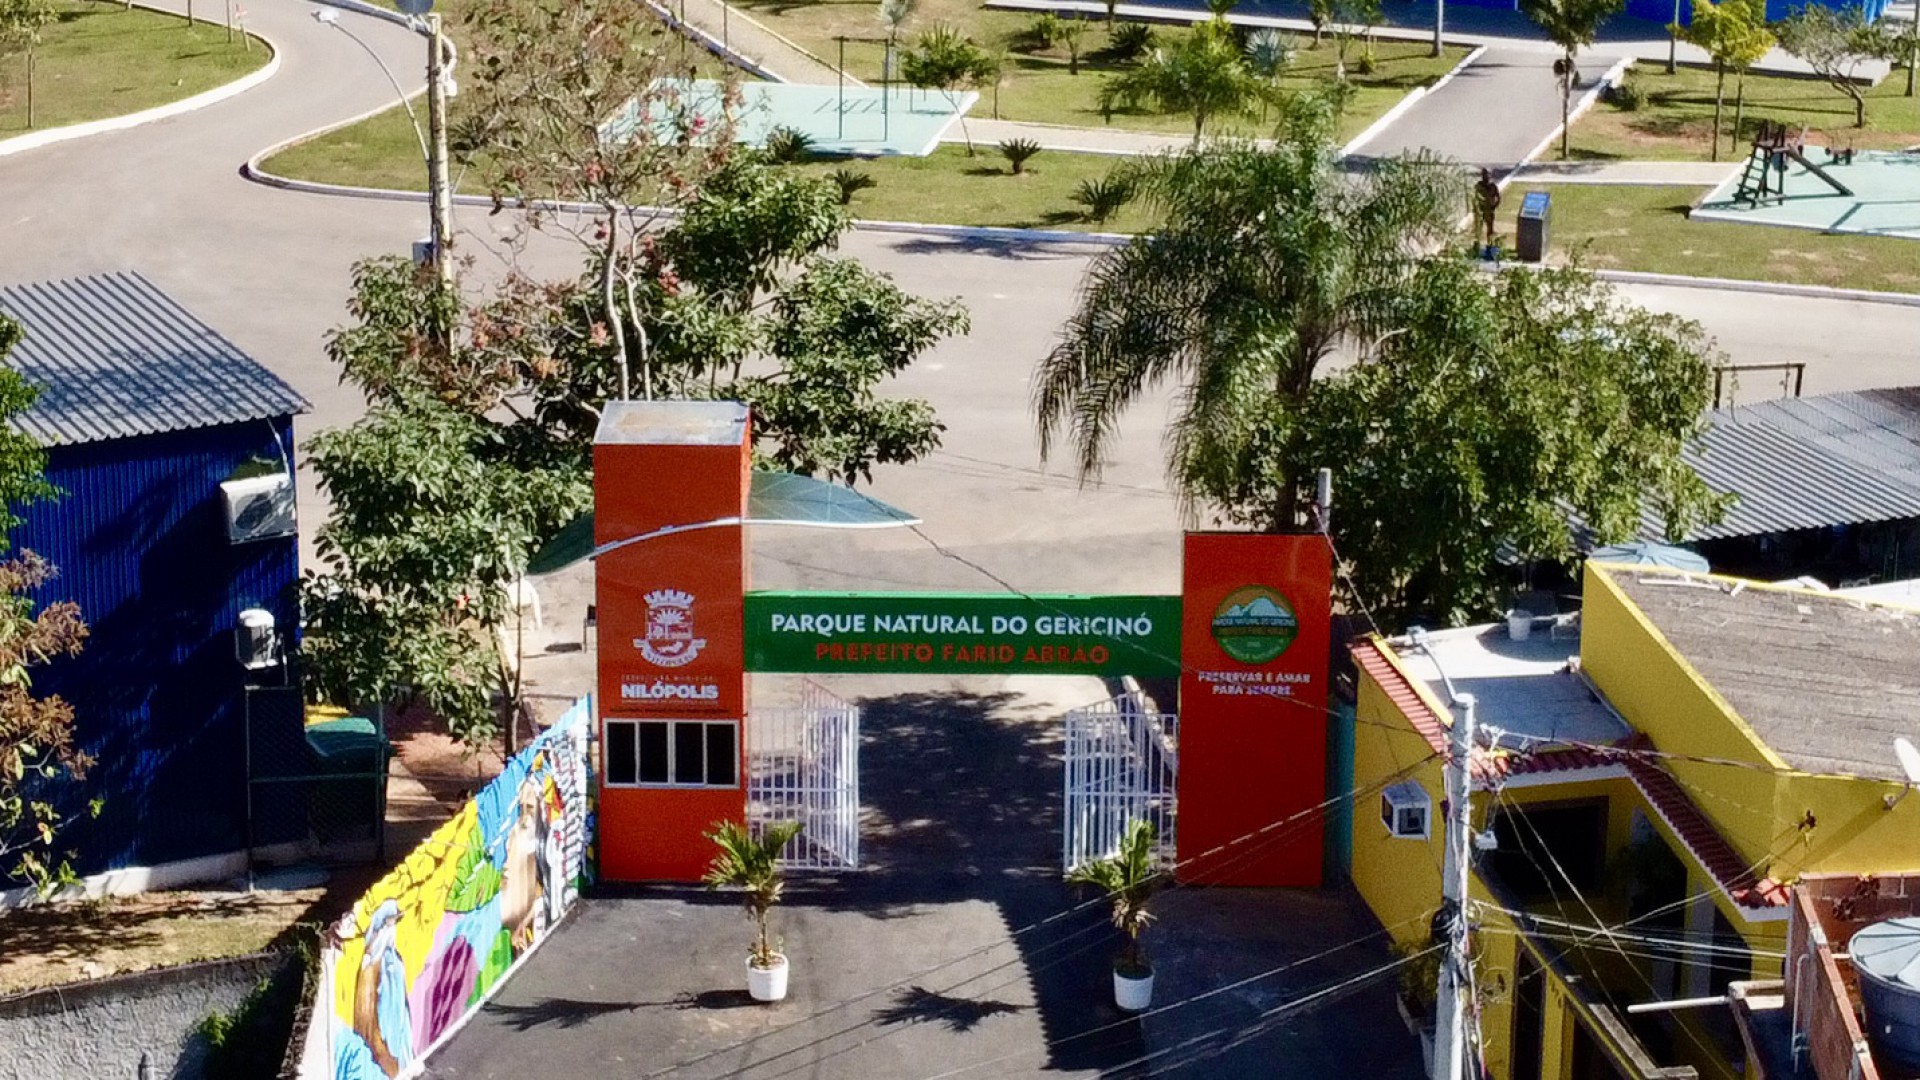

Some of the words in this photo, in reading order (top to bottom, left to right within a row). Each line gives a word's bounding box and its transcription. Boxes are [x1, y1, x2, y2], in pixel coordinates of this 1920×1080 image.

[771, 614, 866, 637] PARQUE
[873, 614, 985, 635] NATURAL
[991, 616, 1028, 635] DO
[1034, 611, 1153, 636] GERICINÓ
[815, 643, 934, 663] PREFEITO
[942, 644, 1016, 664] FARID
[621, 680, 719, 699] NILÓPOLIS
[1212, 685, 1243, 696] PARA
